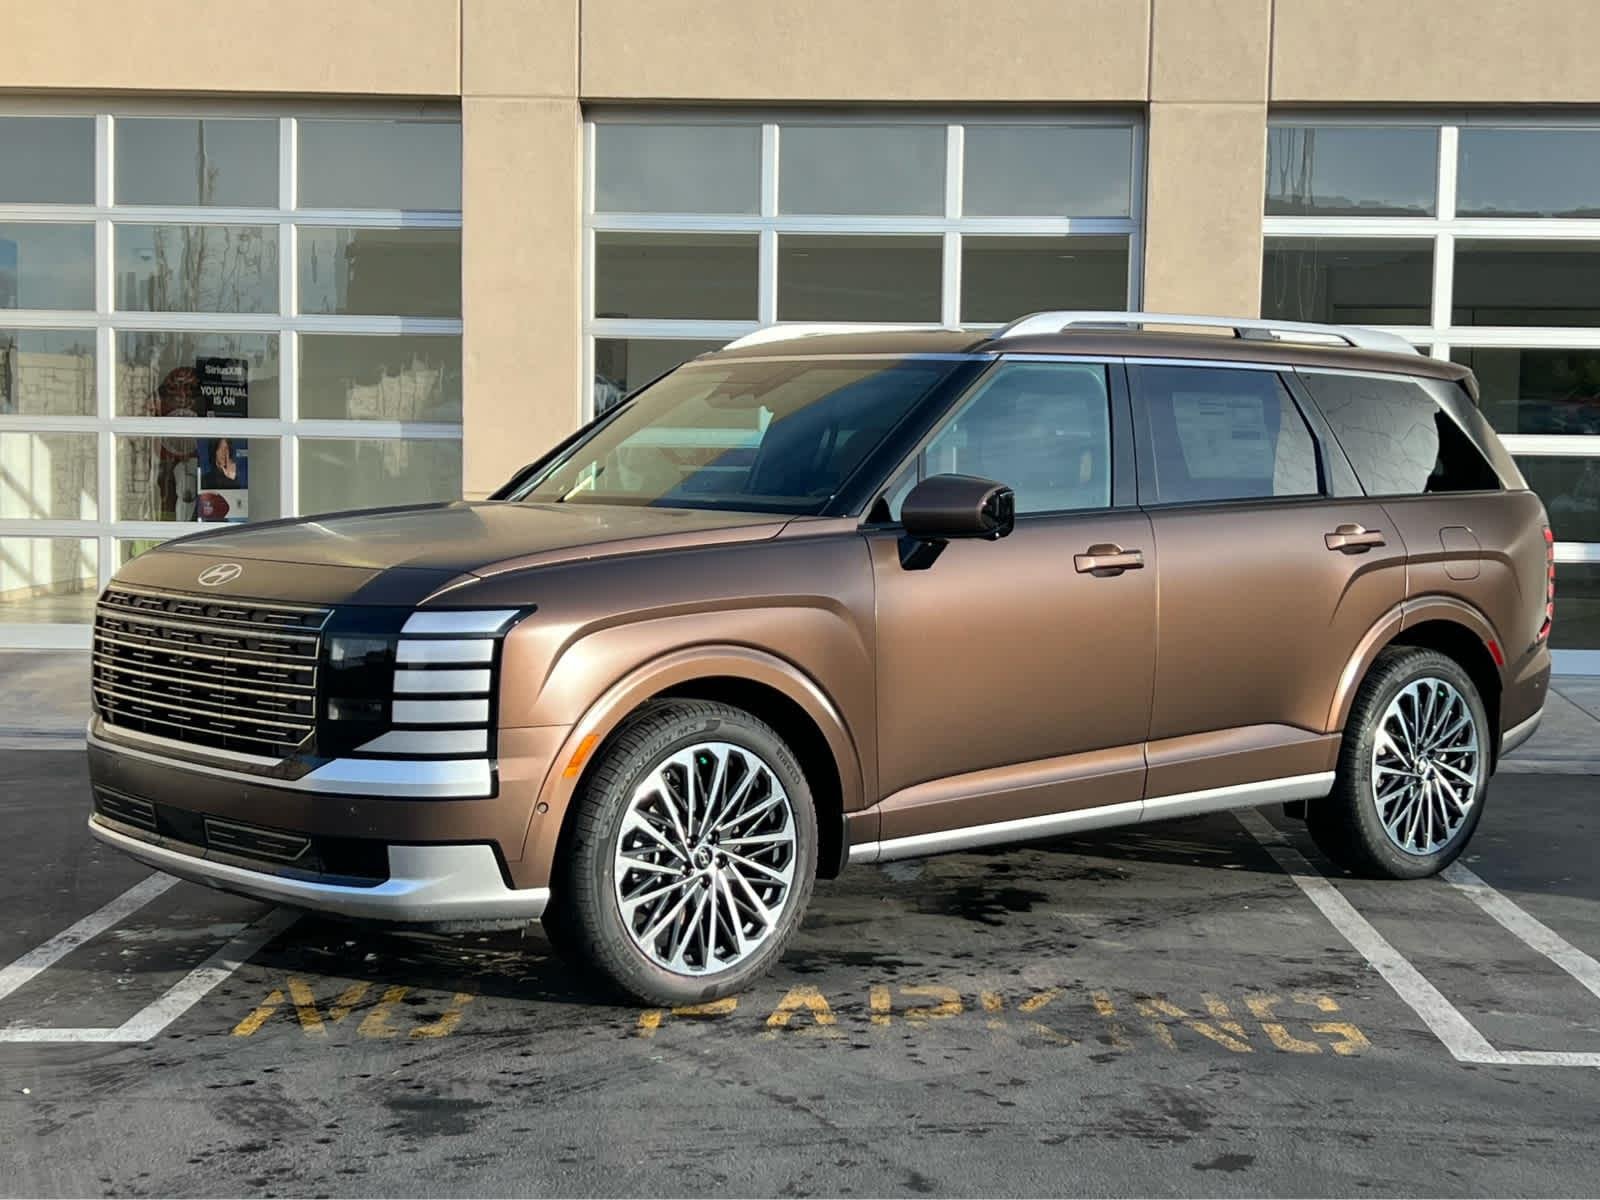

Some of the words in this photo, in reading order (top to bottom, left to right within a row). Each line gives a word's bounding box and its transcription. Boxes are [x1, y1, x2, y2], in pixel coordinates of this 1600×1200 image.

[200, 386, 223, 396] YOUR
[224, 387, 248, 397] TRIAL
[213, 396, 221, 405] IS
[223, 396, 235, 406] ON
